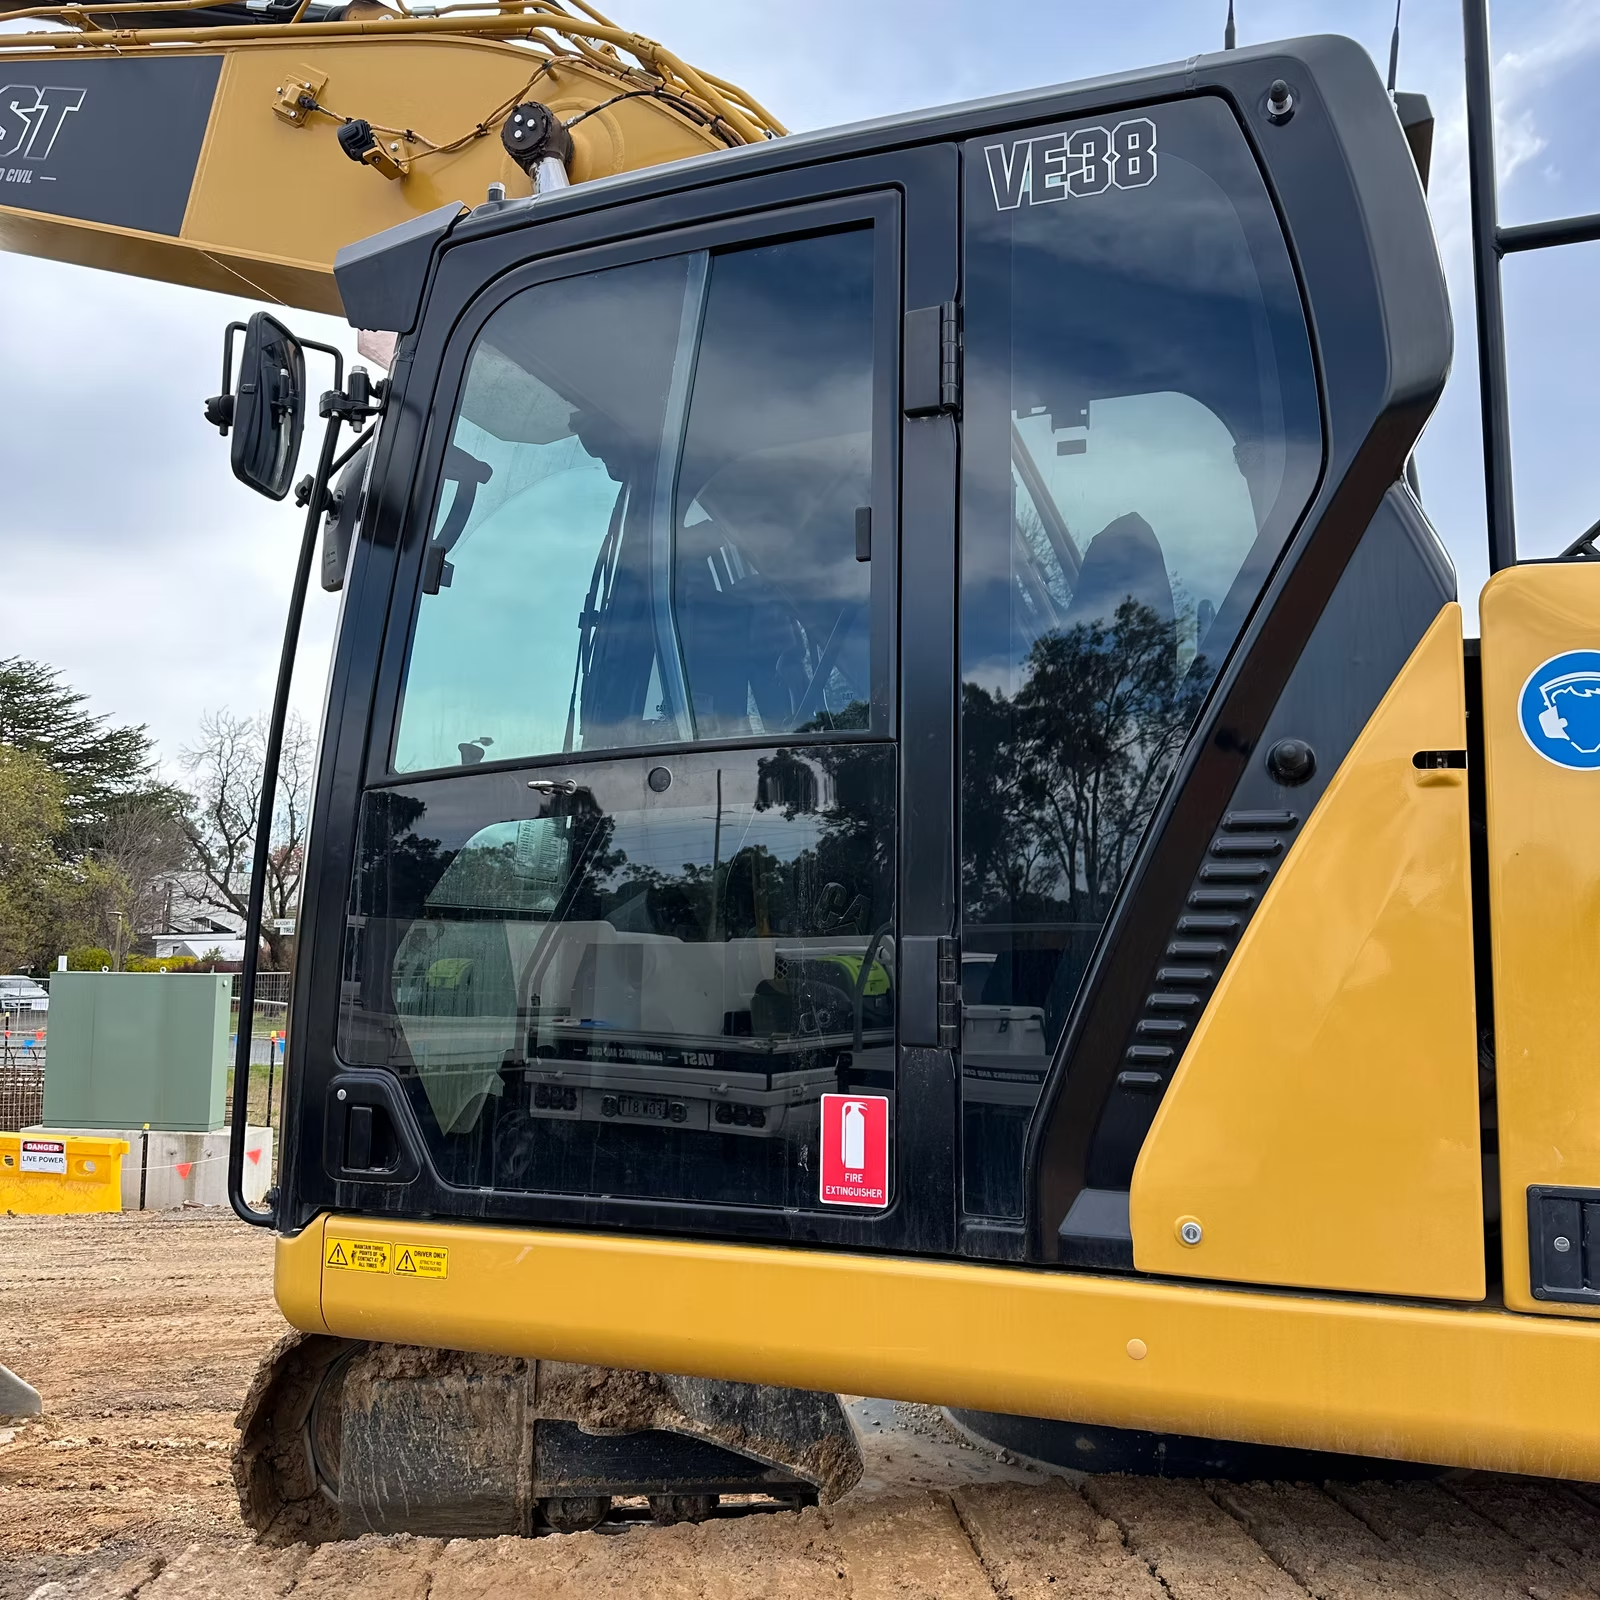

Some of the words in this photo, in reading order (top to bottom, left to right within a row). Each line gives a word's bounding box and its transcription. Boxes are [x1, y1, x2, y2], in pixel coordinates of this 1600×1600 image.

[0, 84, 88, 160] ST
[983, 117, 1158, 212] VE38
[5, 168, 33, 184] CIVIL
[26, 1143, 60, 1152] DANGER
[38, 1156, 64, 1164] POWER
[844, 1172, 864, 1184] FIRE
[825, 1185, 883, 1199] EXTINGUISHER
[414, 1250, 432, 1258] DRIVER
